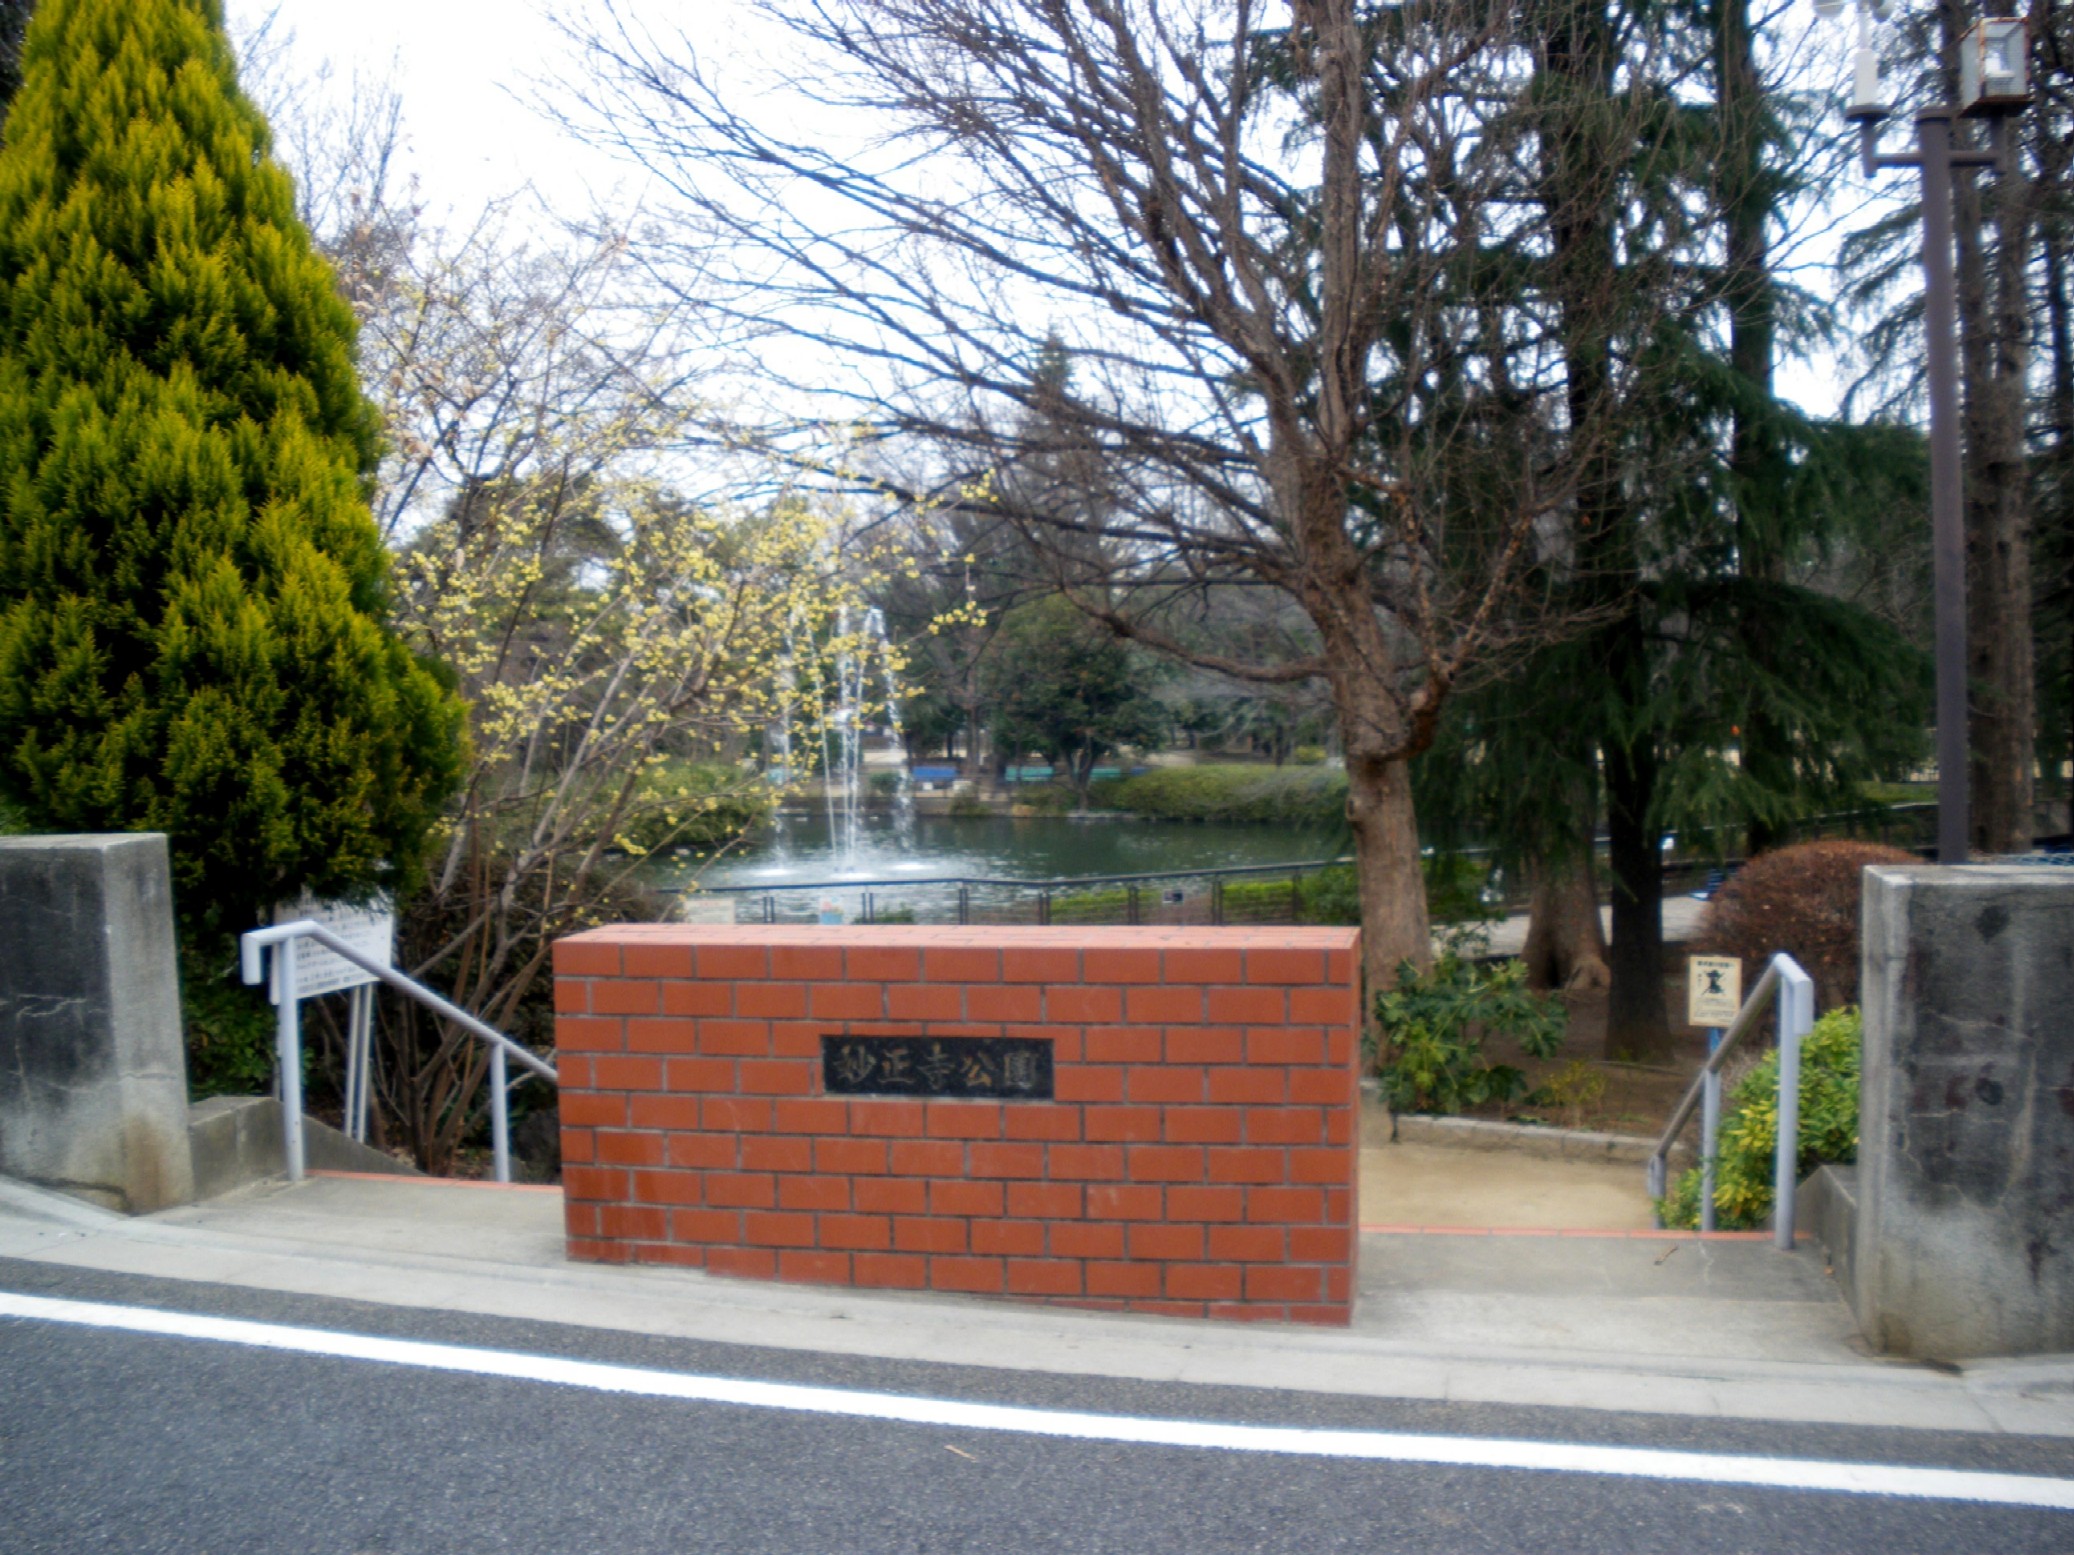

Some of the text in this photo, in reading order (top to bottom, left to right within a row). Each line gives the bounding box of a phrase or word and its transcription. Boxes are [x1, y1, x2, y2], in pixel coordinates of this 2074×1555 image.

[833, 1042, 1038, 1090] 妙正寺公園
